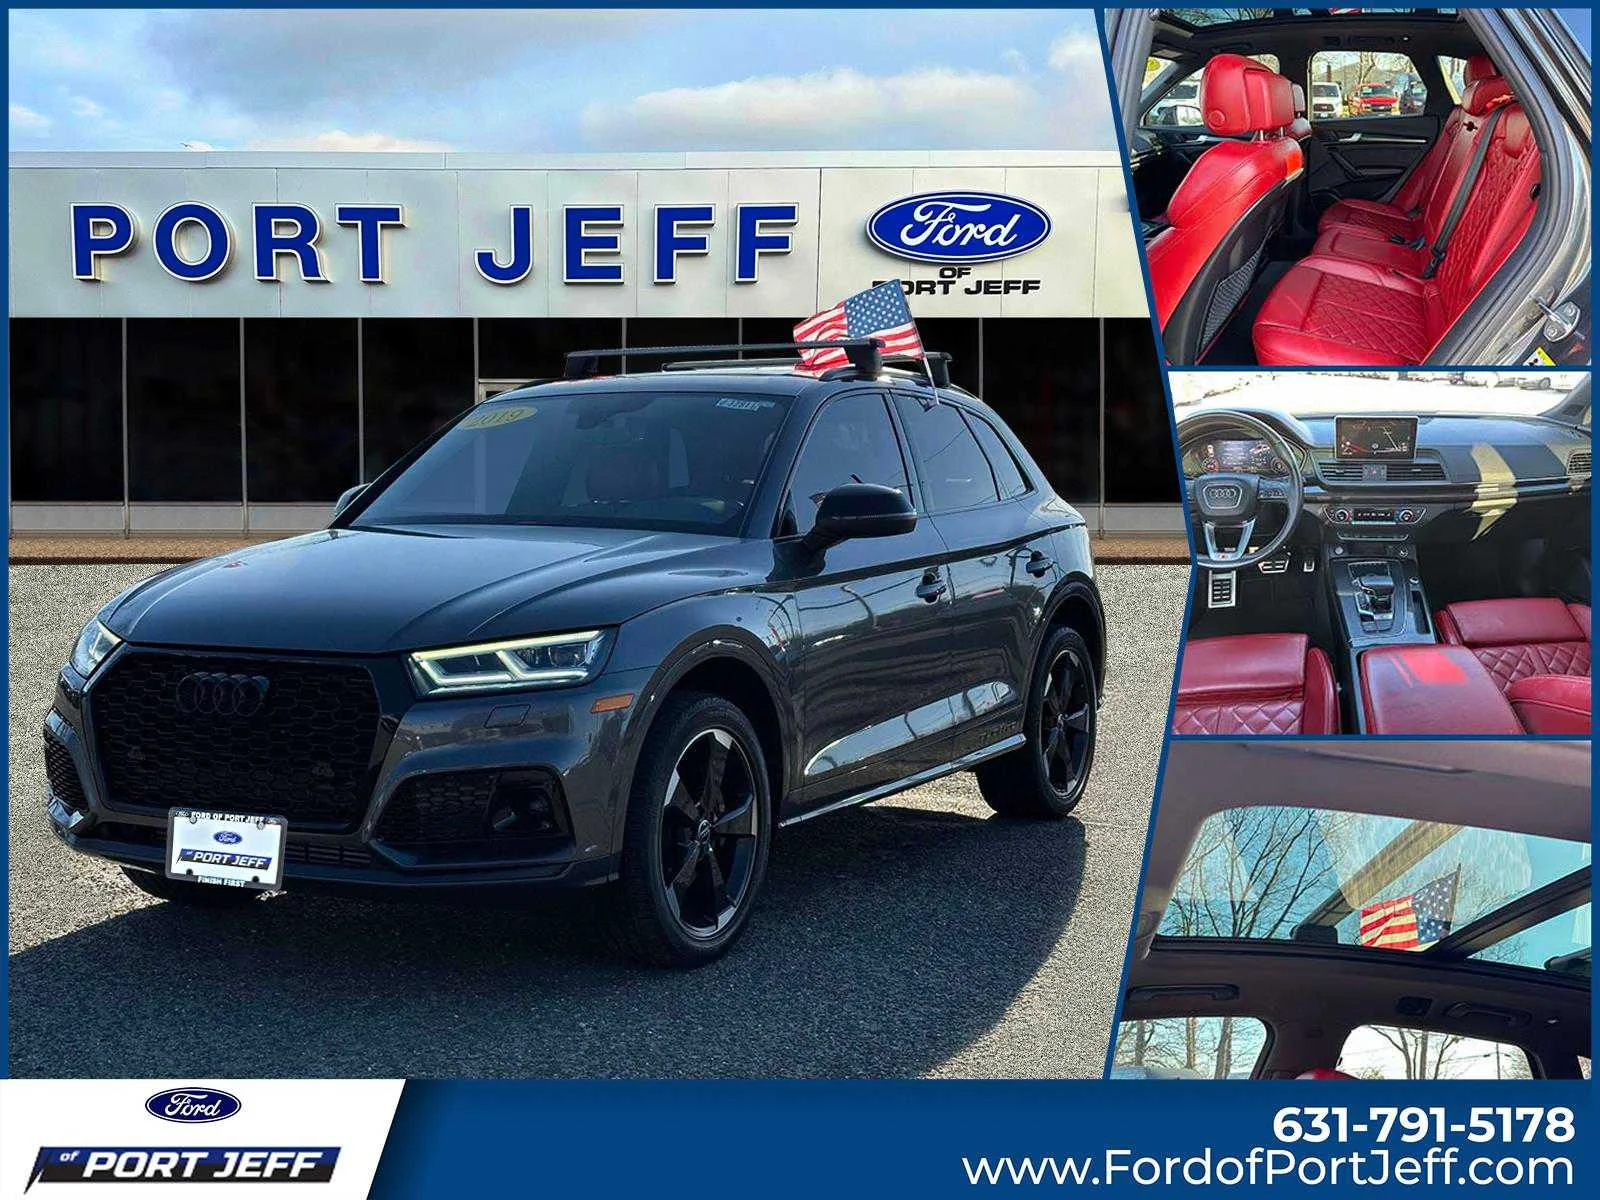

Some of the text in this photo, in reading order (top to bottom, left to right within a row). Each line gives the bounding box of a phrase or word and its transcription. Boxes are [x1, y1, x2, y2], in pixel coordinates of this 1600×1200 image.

[899, 200, 1022, 247] Ford
[70, 202, 799, 285] PORT JEFF
[938, 266, 972, 279] OF
[964, 280, 1041, 295] JEFF
[191, 810, 212, 820] FORD
[212, 812, 223, 821] OF
[224, 813, 245, 823] PORT
[245, 815, 265, 824] JEFF
[218, 831, 238, 843] Ford
[193, 852, 231, 864] PORT
[231, 855, 267, 868] JEFF
[197, 875, 246, 888] FINISH FIRST
